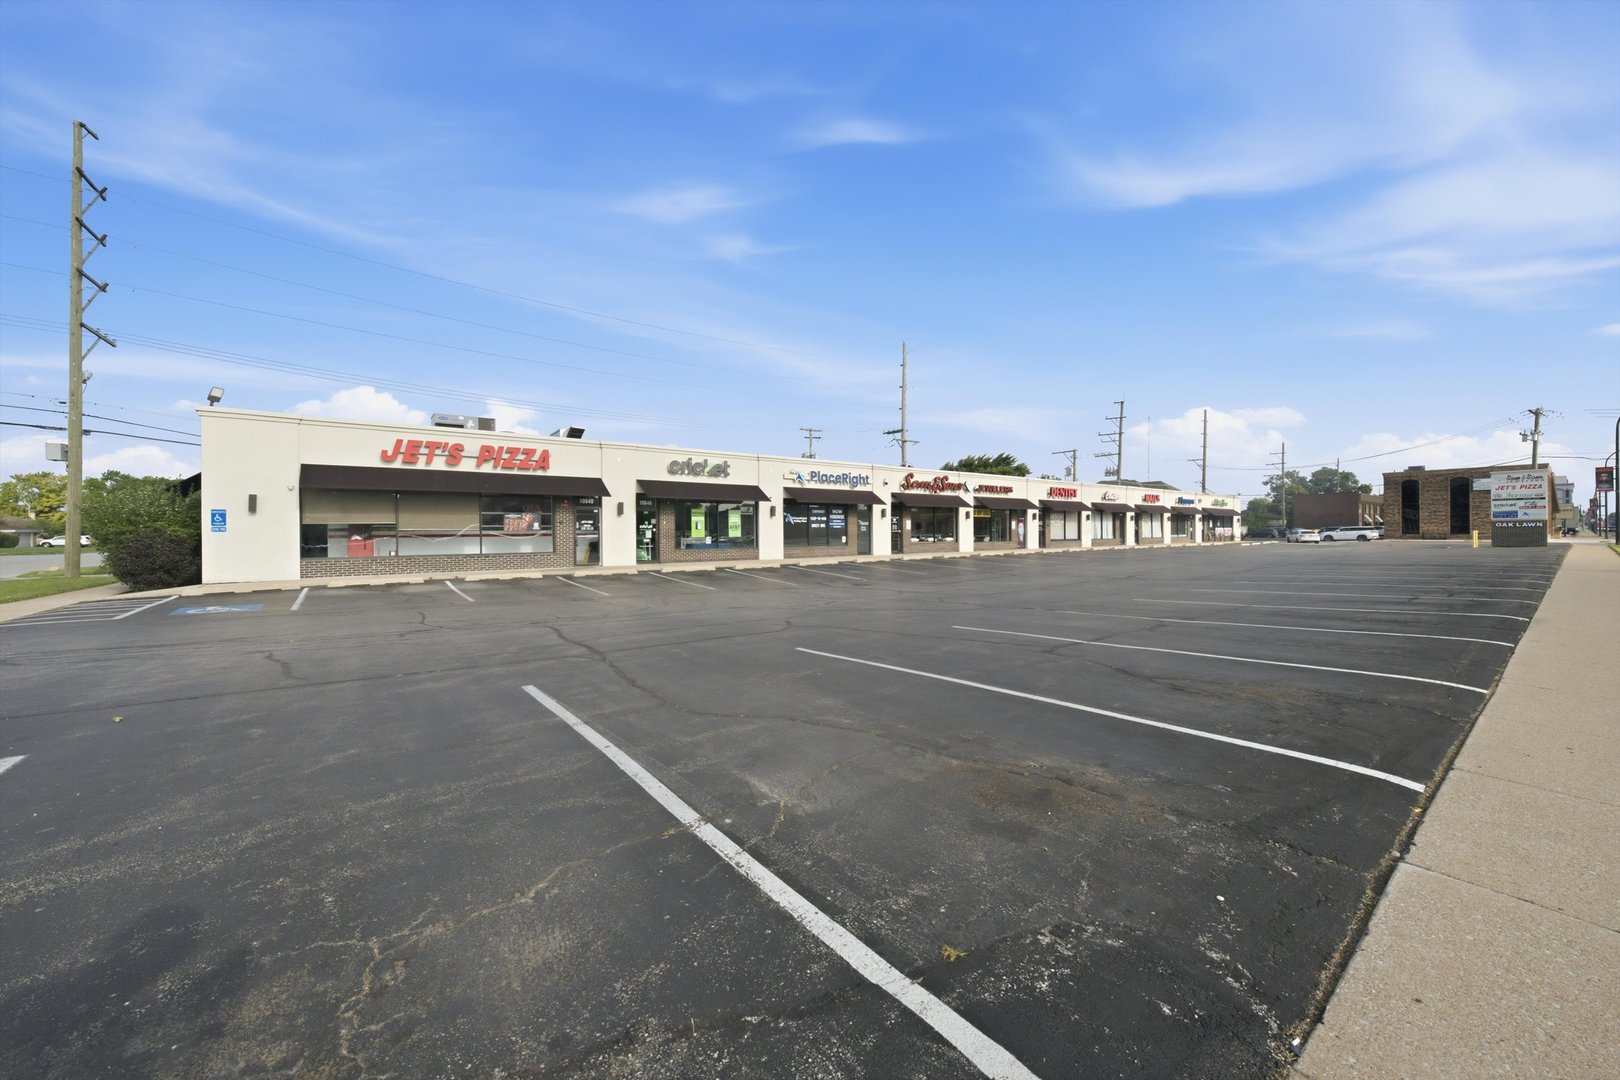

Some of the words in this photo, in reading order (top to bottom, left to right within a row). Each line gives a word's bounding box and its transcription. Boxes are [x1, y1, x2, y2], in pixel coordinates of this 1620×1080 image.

[381, 439, 465, 466] JET'S
[476, 445, 550, 472] PIZZA
[667, 457, 730, 478] cricket
[810, 470, 871, 488] PlaceRight
[1050, 487, 1077, 497] DENTIST
